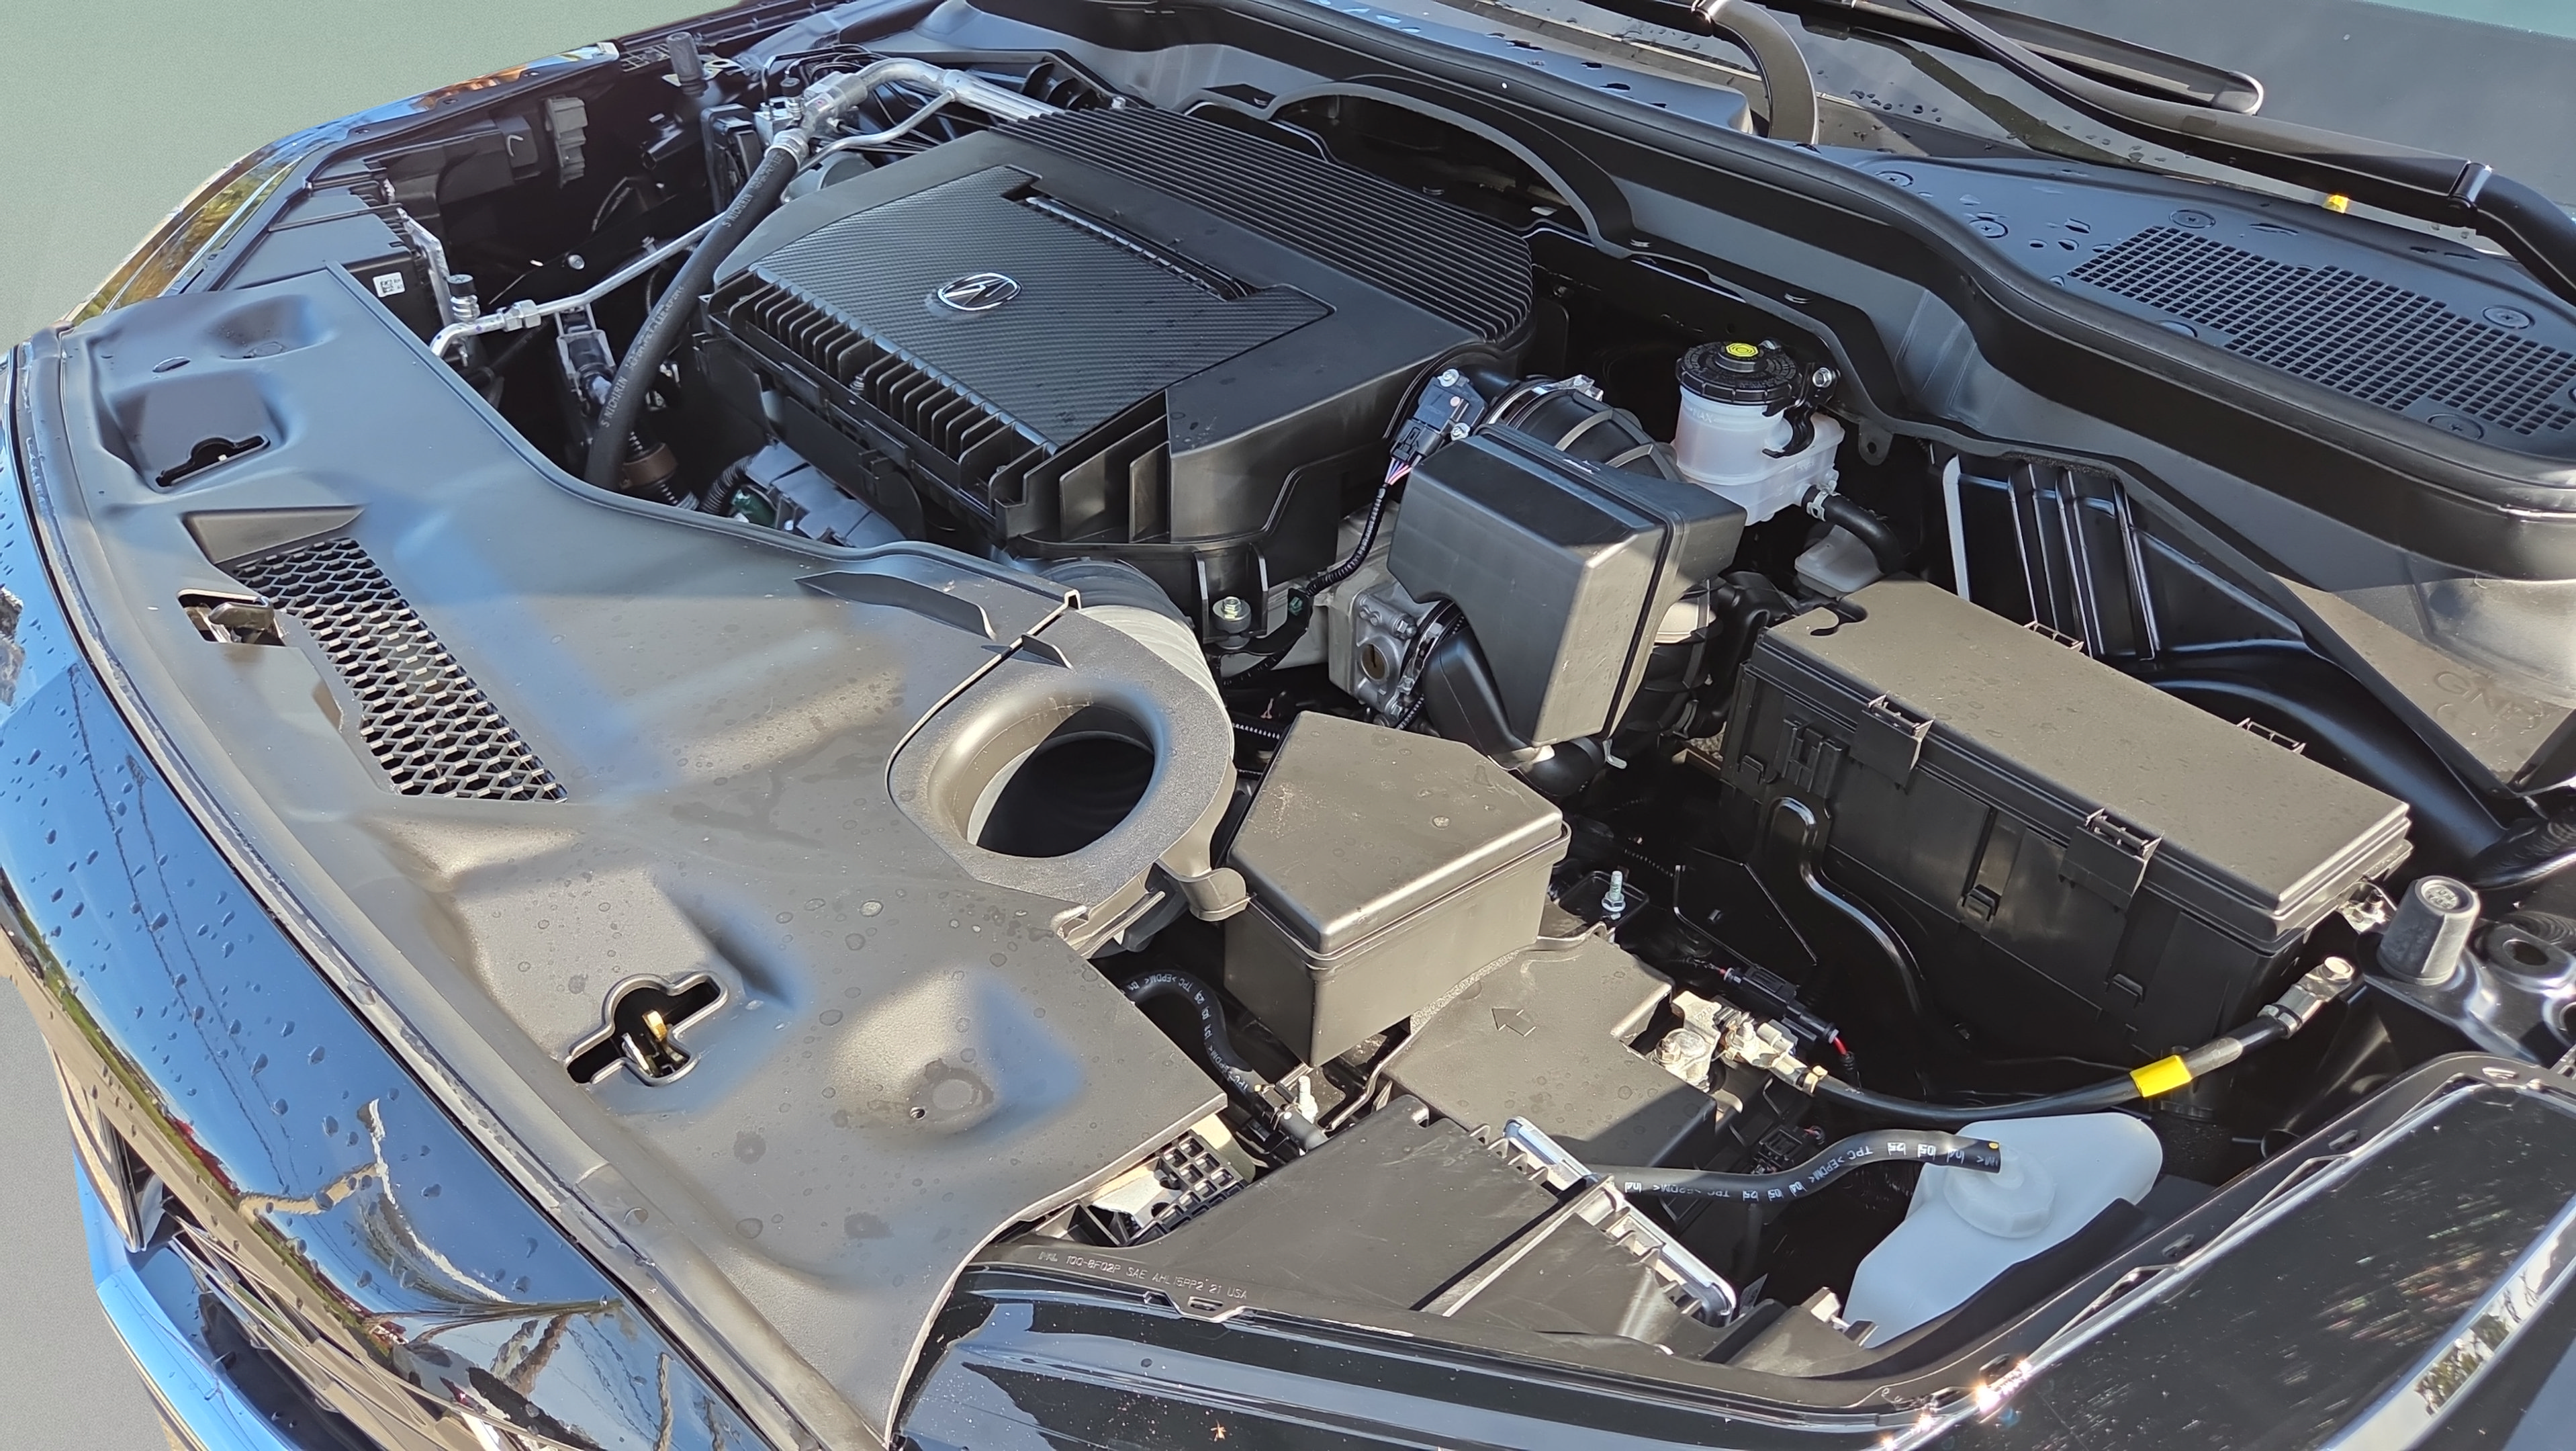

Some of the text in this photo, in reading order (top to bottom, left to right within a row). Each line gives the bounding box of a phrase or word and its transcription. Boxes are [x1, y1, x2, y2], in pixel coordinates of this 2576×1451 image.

[604, 376, 629, 419] NICHIRIN
[1693, 408, 1712, 423] MAX
[1144, 973, 1177, 983] >EPDM<
[1178, 977, 1194, 993] TPC
[1846, 1145, 1874, 1160] TPC
[1808, 1155, 1845, 1183] >EPDM<
[1125, 1267, 1148, 1280] SAE
[1226, 1287, 1248, 1299] USA
